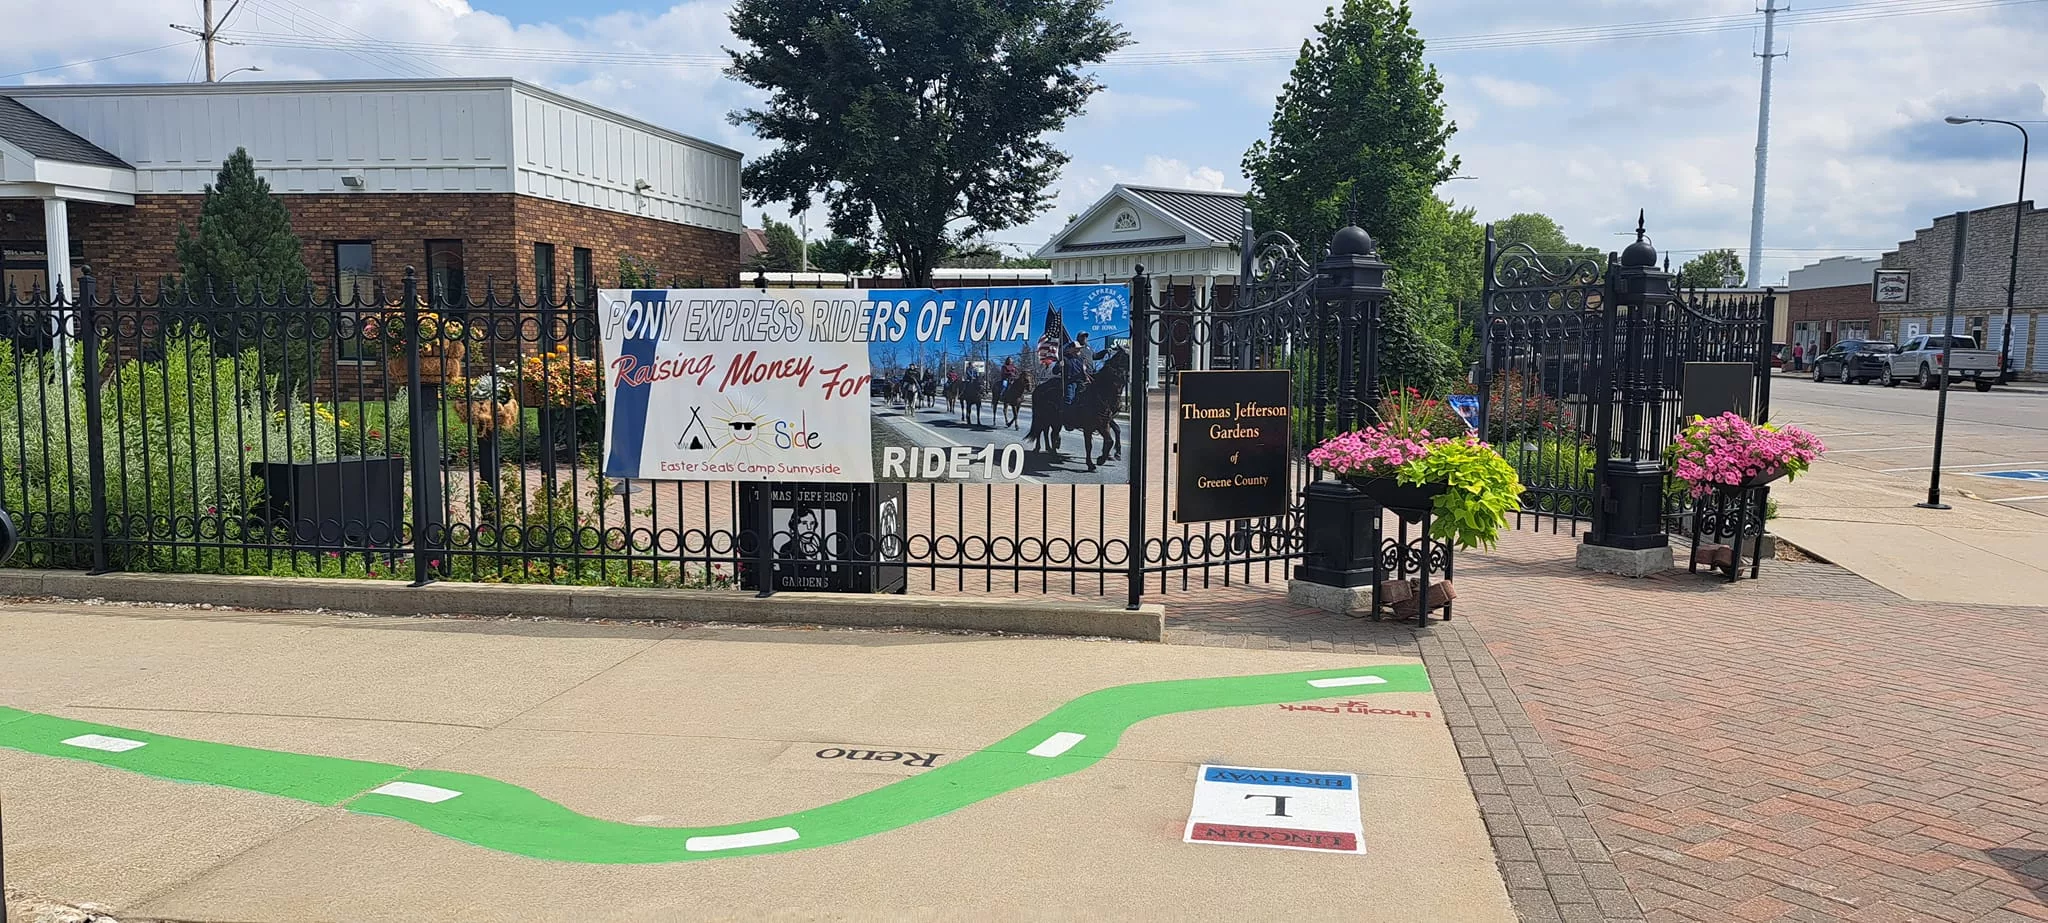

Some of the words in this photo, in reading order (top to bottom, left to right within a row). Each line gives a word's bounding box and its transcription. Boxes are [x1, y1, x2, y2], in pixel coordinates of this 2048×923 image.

[605, 299, 683, 341] PONY
[683, 299, 805, 342] EXPRESS
[809, 299, 911, 342] RIDERS
[916, 299, 956, 342] OF
[958, 298, 1032, 342] IOWA
[611, 352, 716, 389] Raising
[718, 350, 815, 393] Money
[819, 363, 871, 401] For
[1182, 403, 1231, 420] Thomas
[1234, 401, 1287, 421] Jefferson
[774, 409, 822, 450] Side
[1210, 423, 1260, 439] Gardens
[1230, 451, 1239, 464] of
[661, 461, 698, 472] Easter
[701, 461, 735, 473] Seals
[737, 462, 775, 475] Camp
[778, 462, 841, 476] Sunnyside
[1198, 476, 1232, 489] Greene
[1234, 474, 1269, 487] County
[798, 490, 853, 502] JEFFERSO
[782, 576, 829, 588] GARDENS
[1279, 703, 1340, 714] Park
[1348, 707, 1432, 718] Lincoln
[816, 747, 945, 767] Reno
[1213, 772, 1344, 787] HIGHWAY
[1244, 794, 1293, 817] L
[1206, 828, 1343, 846] LINCOLN
